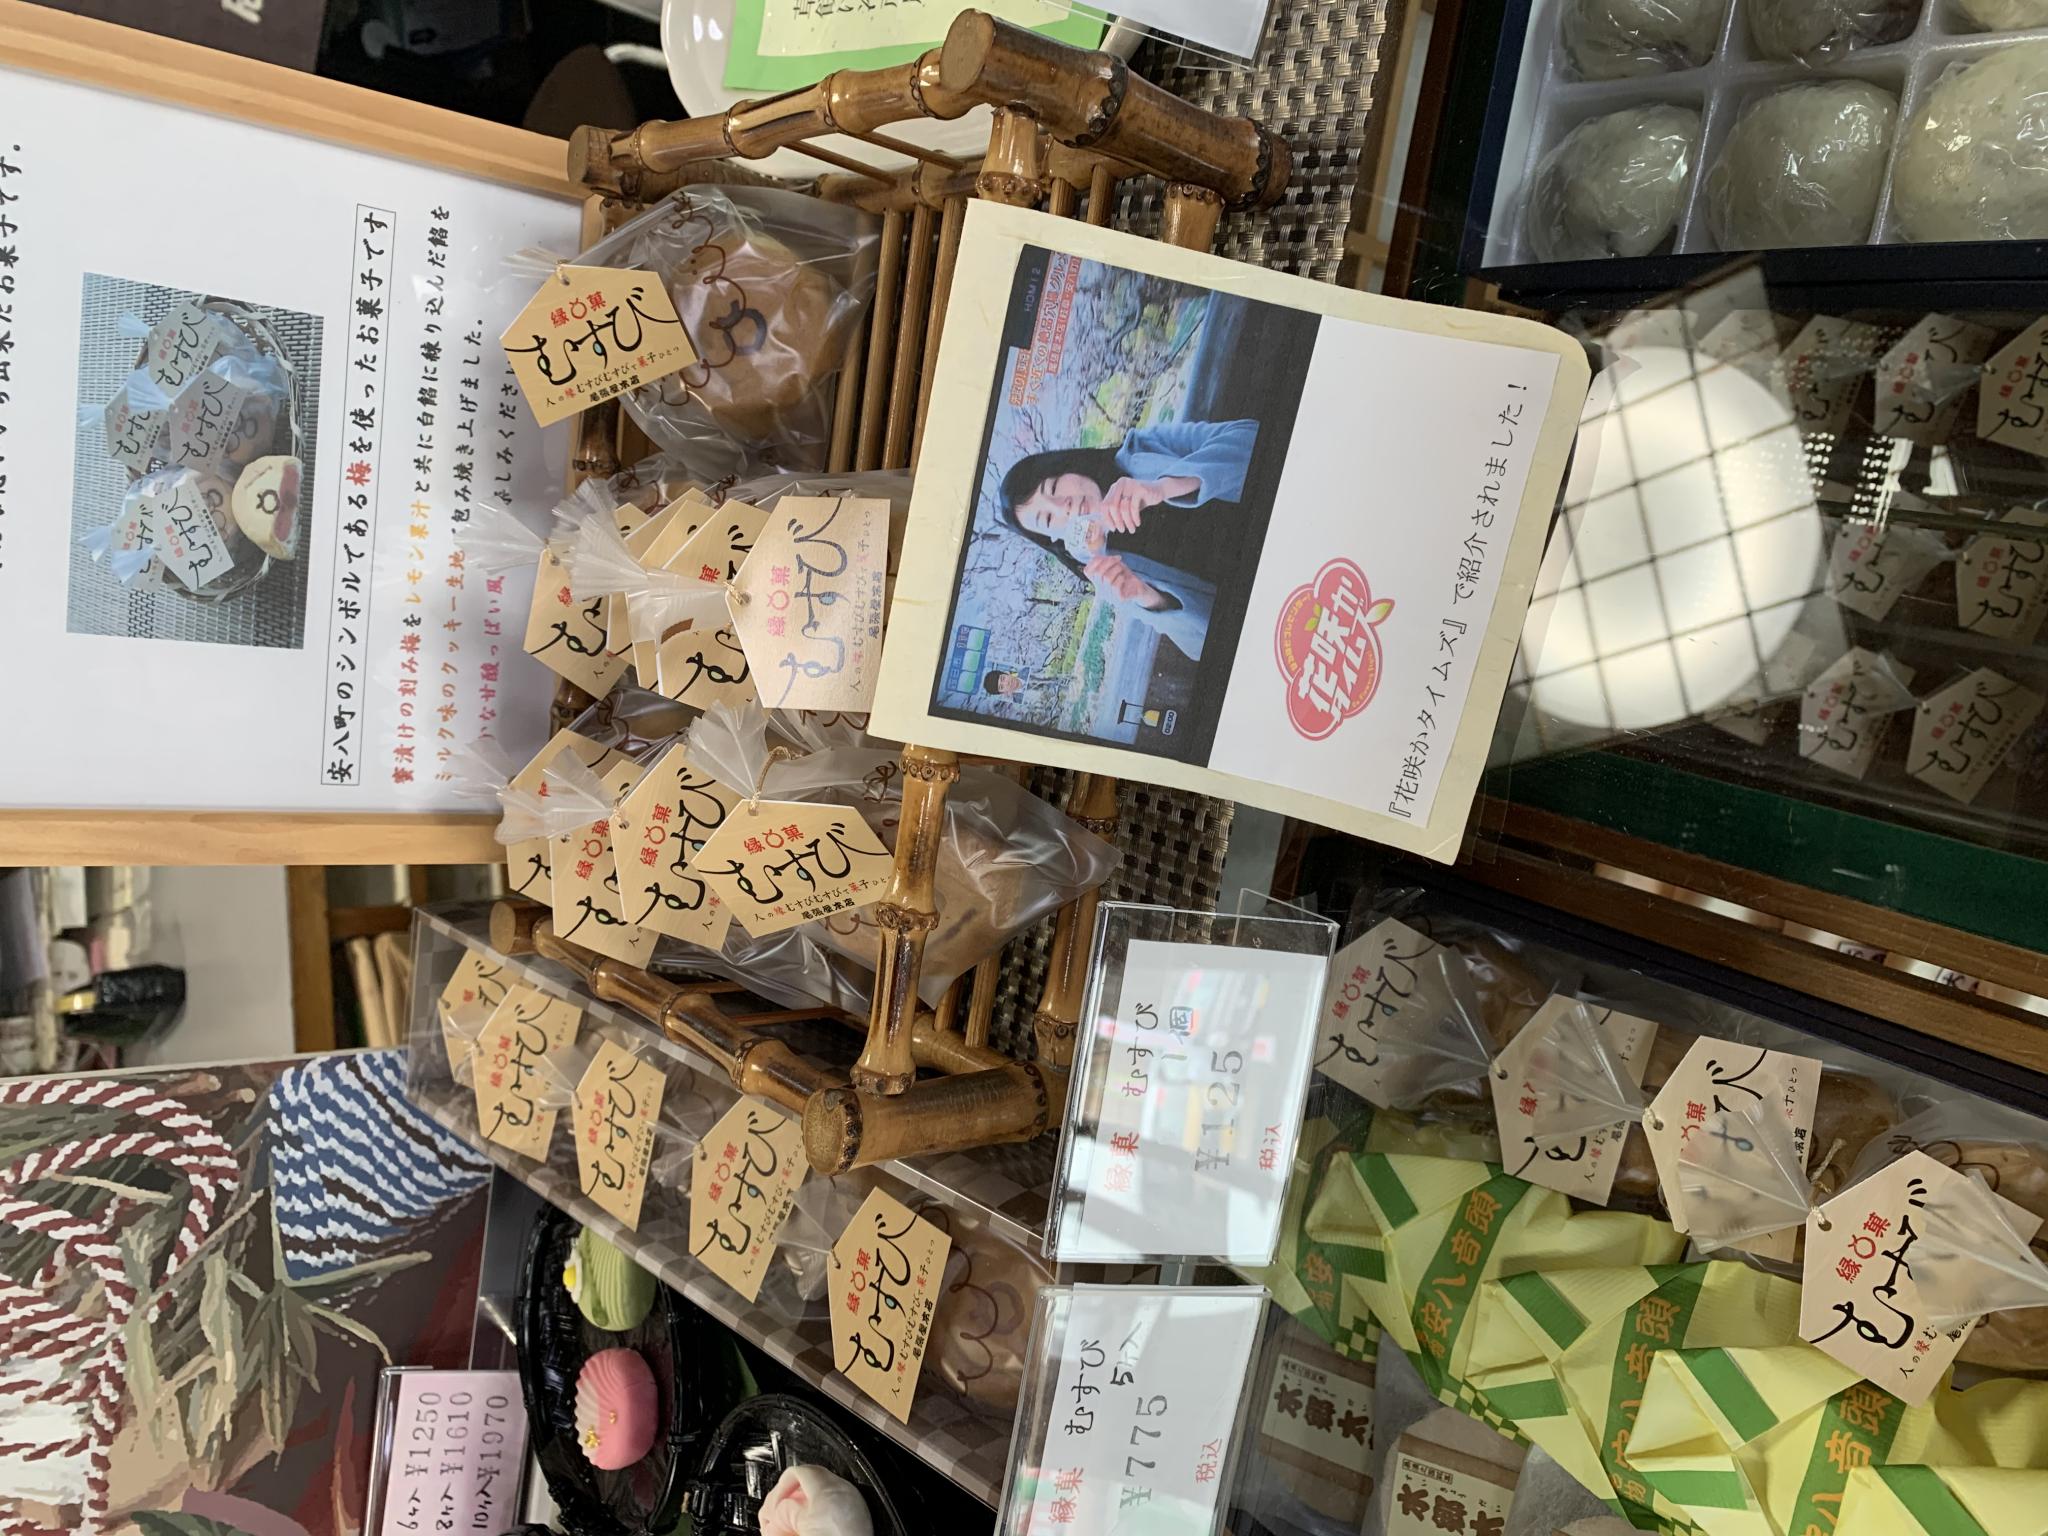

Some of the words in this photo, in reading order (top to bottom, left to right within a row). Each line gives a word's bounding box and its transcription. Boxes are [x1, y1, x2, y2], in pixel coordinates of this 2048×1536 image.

[504, 285, 681, 386] むすび
[326, 211, 389, 784] 安八町のシンボルである梅を使ったお菓子です
[434, 319, 484, 782] ミルク味のクッキー生地包み焼き上げました。
[775, 496, 851, 708] むすび
[635, 767, 727, 925] むすび
[697, 822, 890, 904] むすび
[486, 997, 553, 1140] むすび
[1121, 1002, 1159, 1098] むすび
[585, 1056, 640, 1198] むすび
[1193, 1049, 1243, 1172] ¥125
[1258, 1122, 1283, 1171] 税込
[695, 1110, 788, 1257] むすび
[841, 1212, 918, 1374] むすび
[404, 1392, 442, 1477] ¥1250
[439, 1392, 473, 1475] ¥1610
[476, 1395, 509, 1480] ¥1970
[1064, 1339, 1106, 1436] むすび
[1048, 1467, 1085, 1524] 縁菓
[1118, 1394, 1168, 1509] ¥775
[1194, 1438, 1222, 1484] 税込
